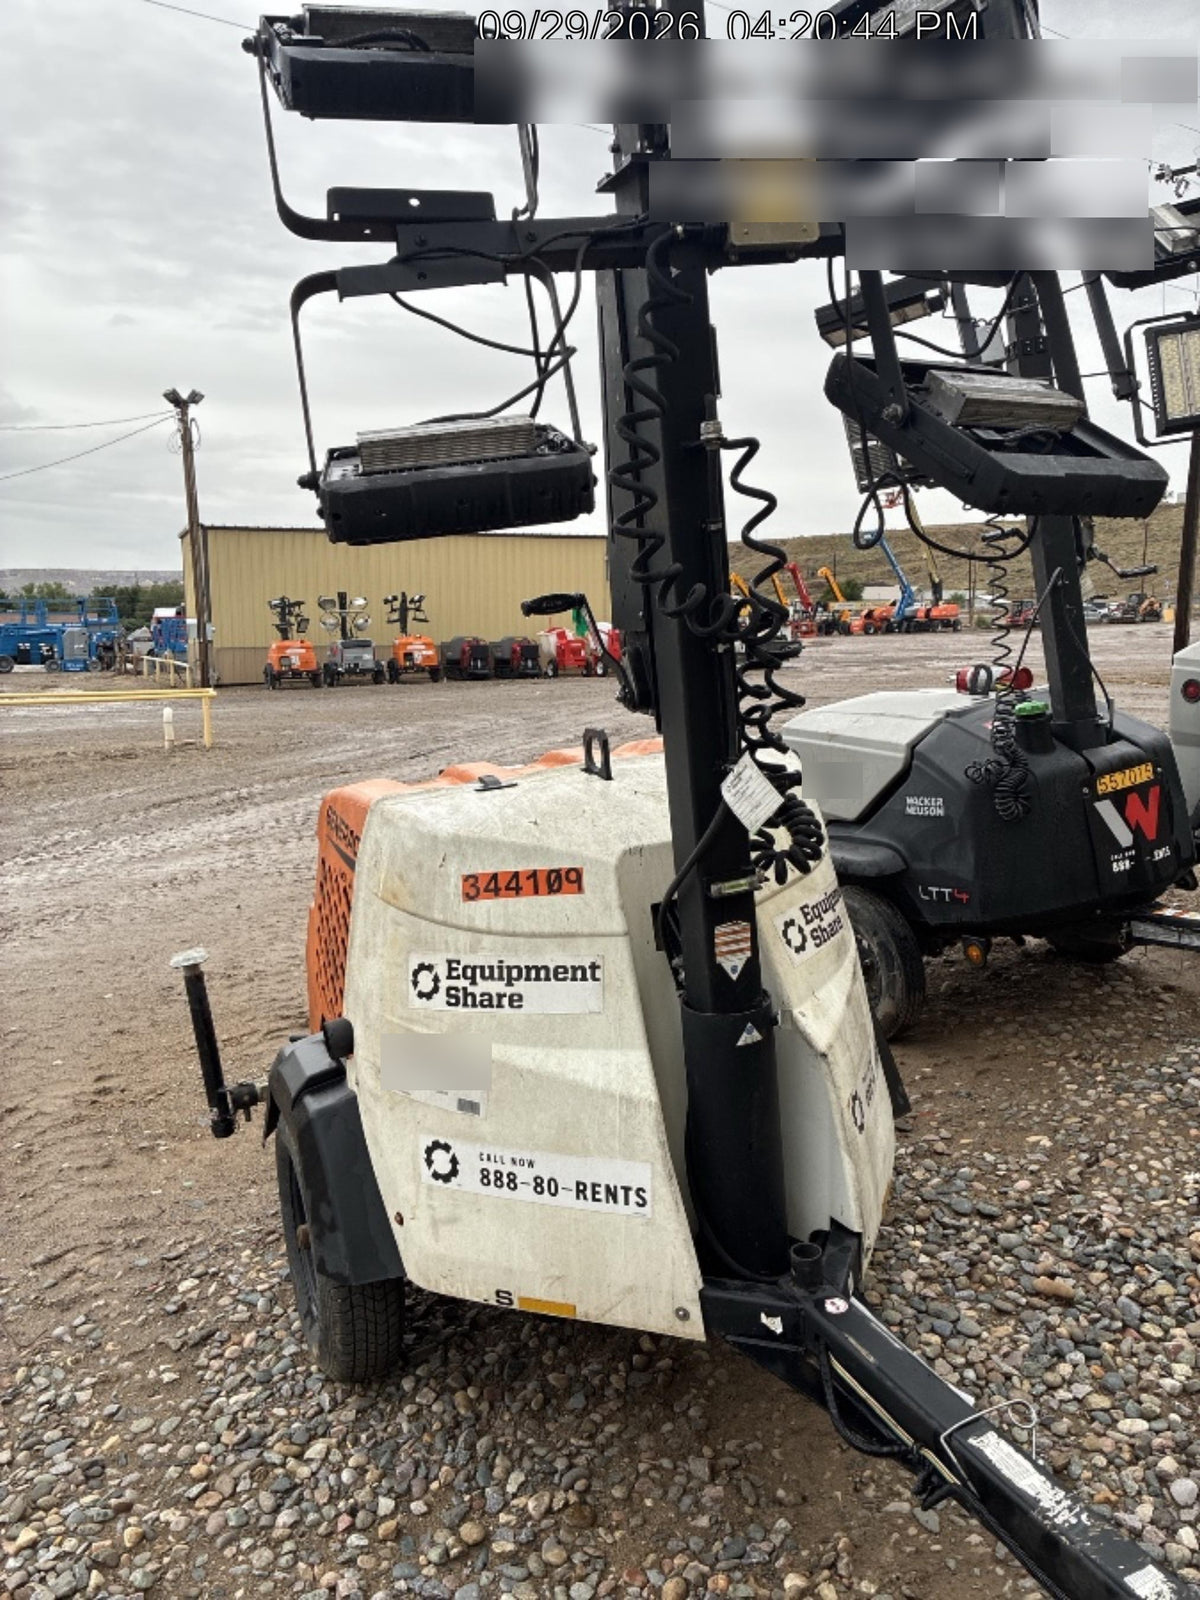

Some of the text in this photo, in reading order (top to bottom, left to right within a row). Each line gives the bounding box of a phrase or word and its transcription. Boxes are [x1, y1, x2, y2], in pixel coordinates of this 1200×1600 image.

[463, 867, 583, 900] 344109
[918, 885, 969, 904] LTT4
[446, 958, 601, 987] Equipment
[446, 986, 524, 1009] Share
[479, 1152, 536, 1169] CALL NOW
[479, 1167, 648, 1208] 888-80-RENTS
